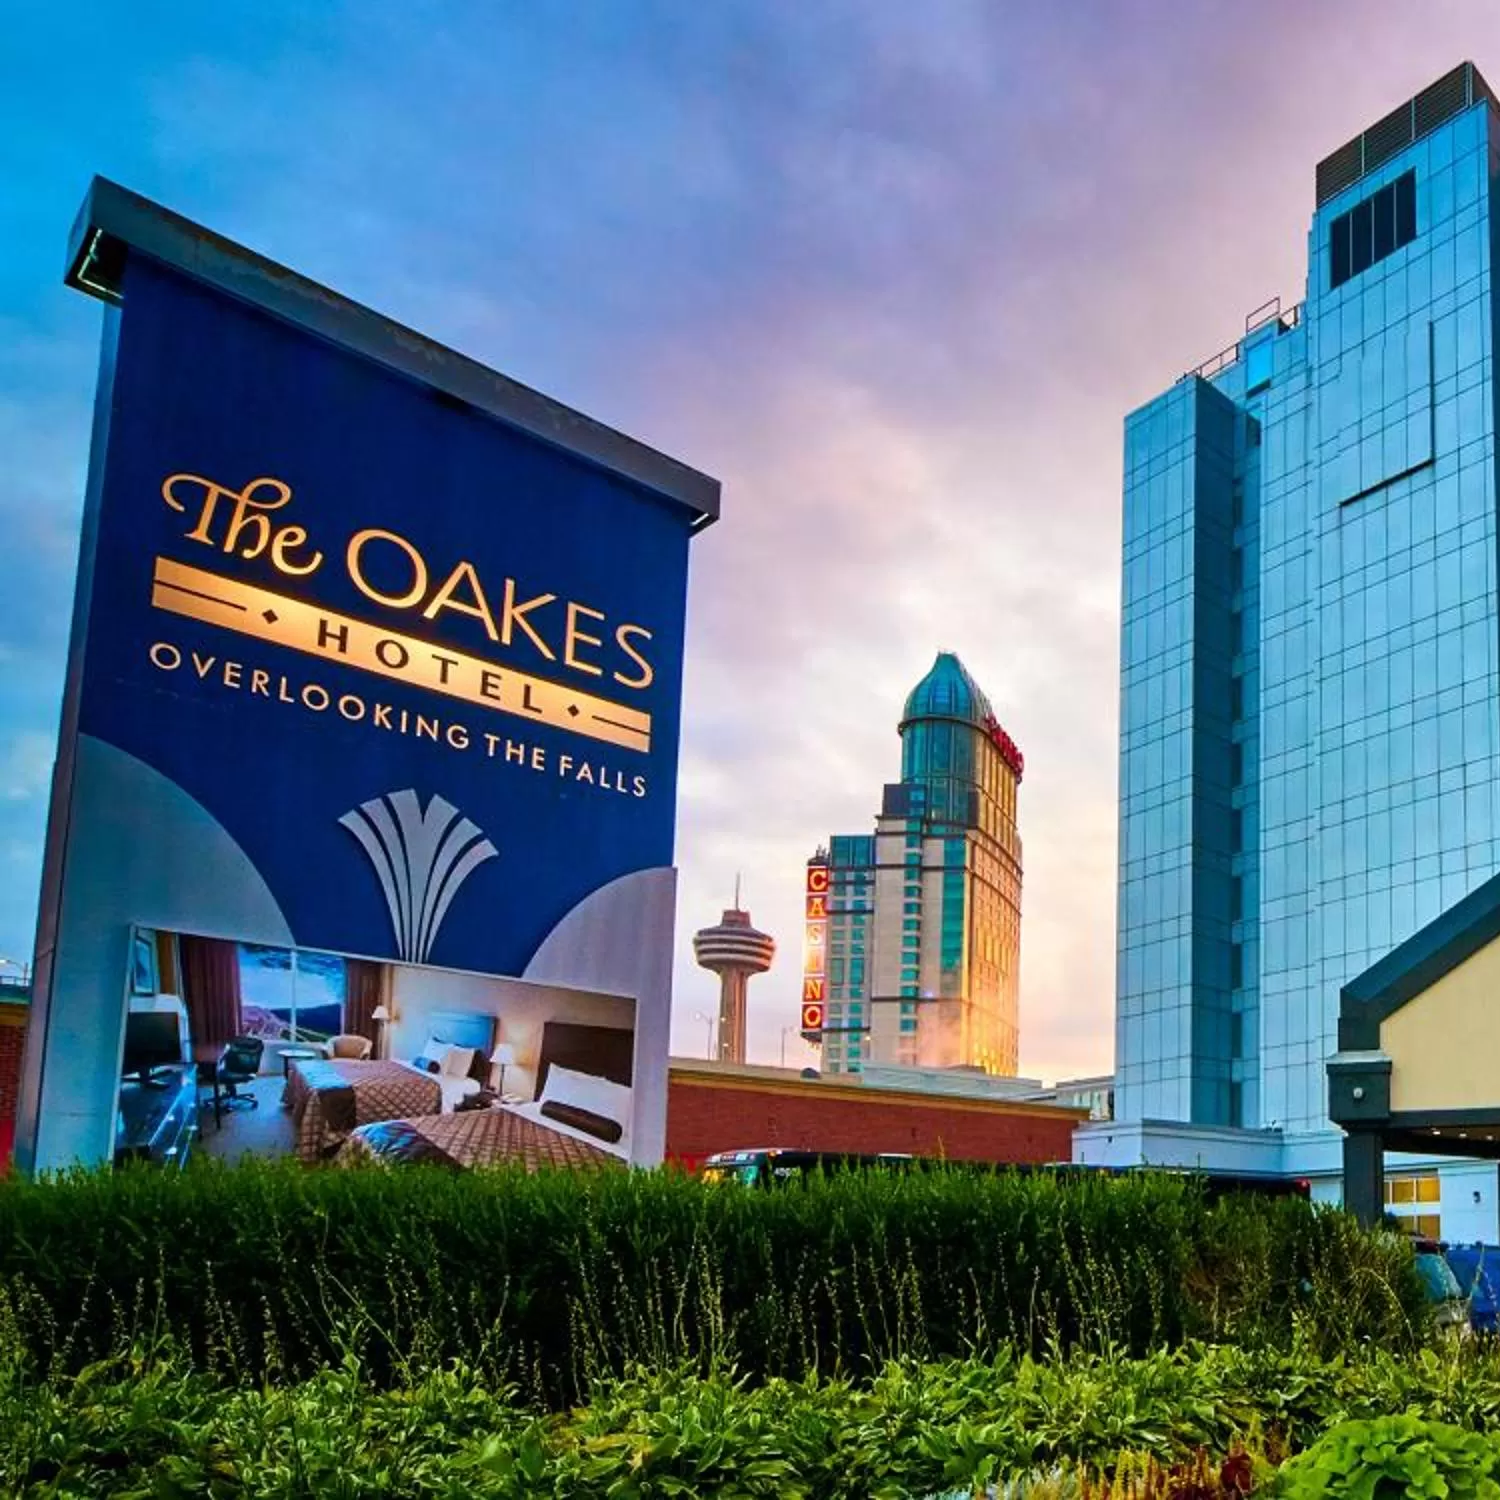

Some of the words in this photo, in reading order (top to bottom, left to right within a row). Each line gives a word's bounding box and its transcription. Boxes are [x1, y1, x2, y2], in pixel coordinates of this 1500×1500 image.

[161, 473, 323, 575] The
[347, 529, 654, 689] OAKES
[149, 642, 471, 750] OVERLOOKING
[484, 734, 545, 772] THE
[560, 754, 647, 797] FALLS
[317, 618, 543, 714] HOTEL
[804, 868, 828, 1028] CASINO
